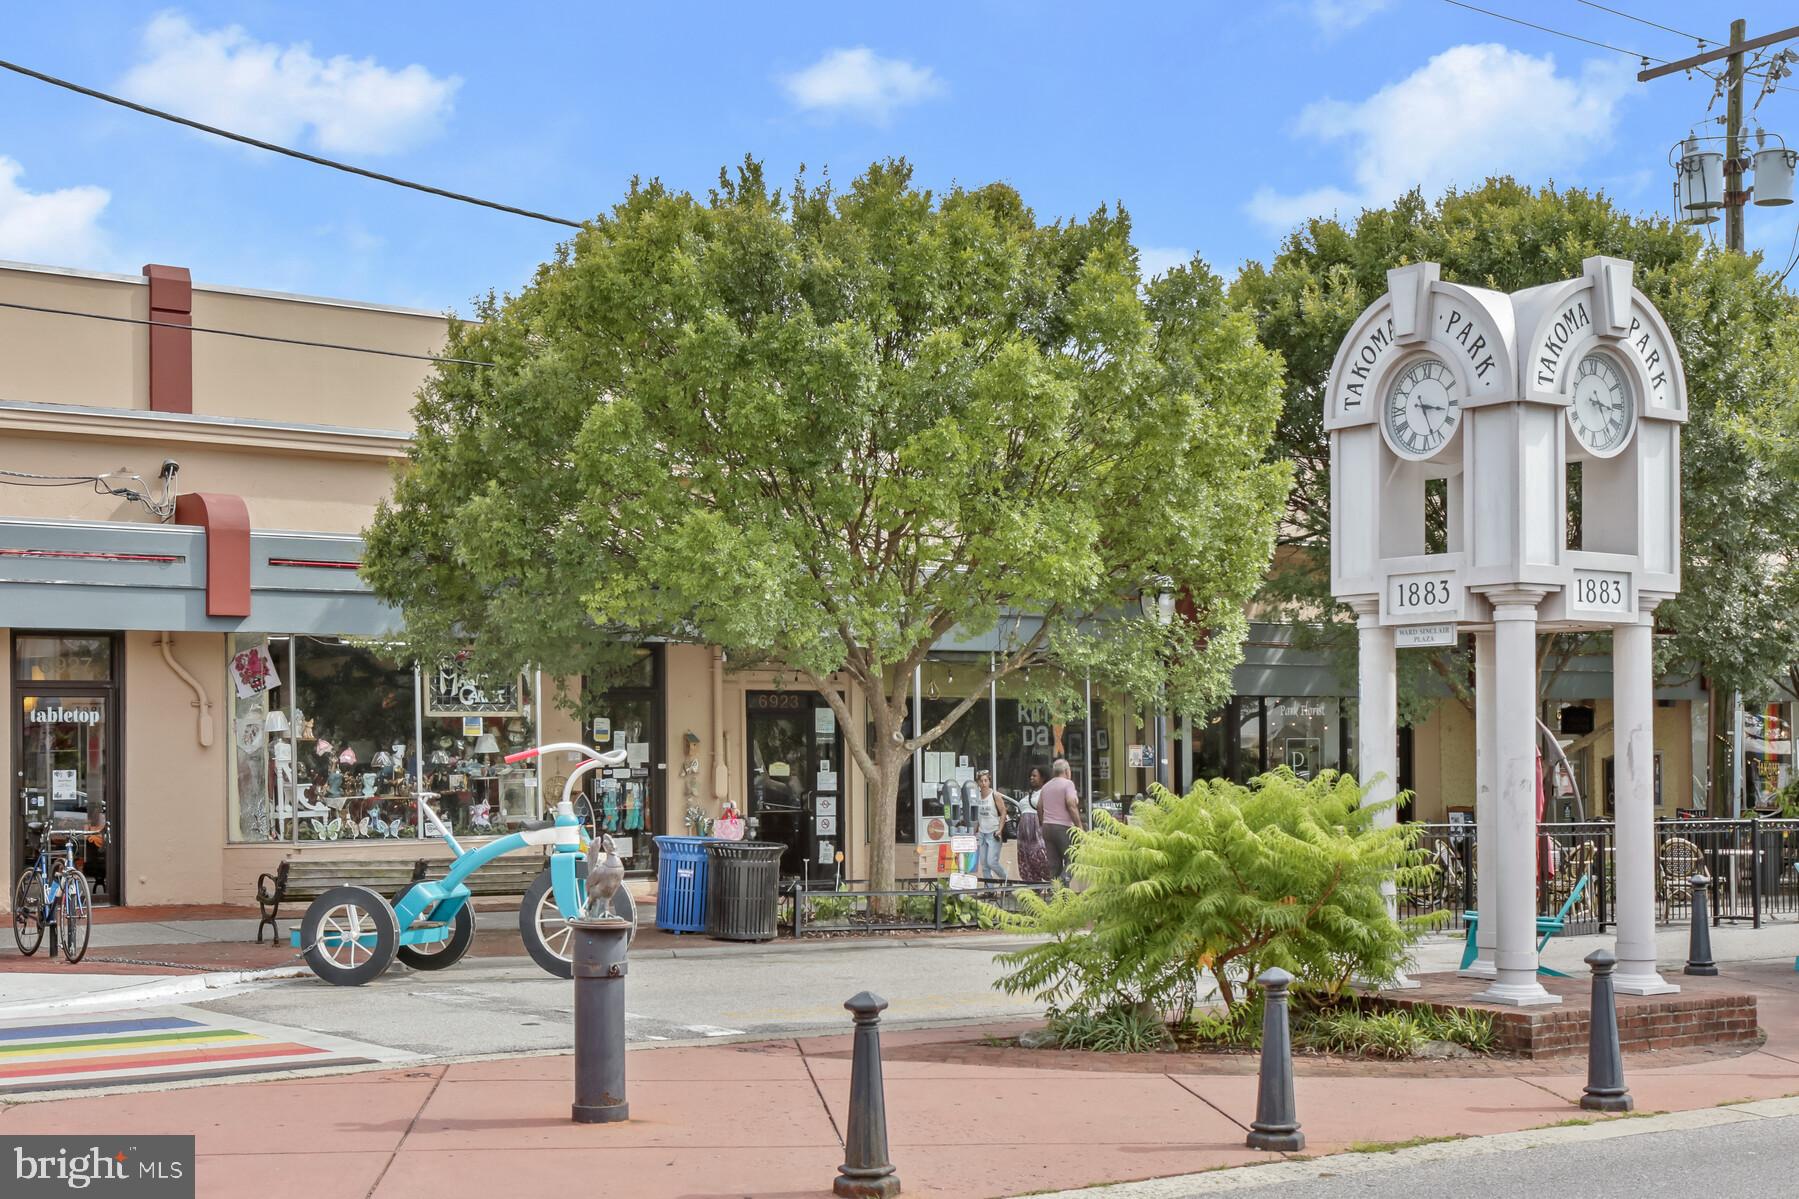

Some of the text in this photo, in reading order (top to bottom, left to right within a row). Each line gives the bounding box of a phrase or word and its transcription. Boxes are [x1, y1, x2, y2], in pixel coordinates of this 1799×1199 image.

[1445, 310, 1496, 379] PARK
[1538, 302, 1668, 391] TAKOMA PARK
[1398, 580, 1450, 607] 1883
[1577, 578, 1622, 605] 1883
[759, 695, 800, 709] 6923
[1280, 700, 1326, 718] Park Florist
[30, 706, 100, 726] tabletop
